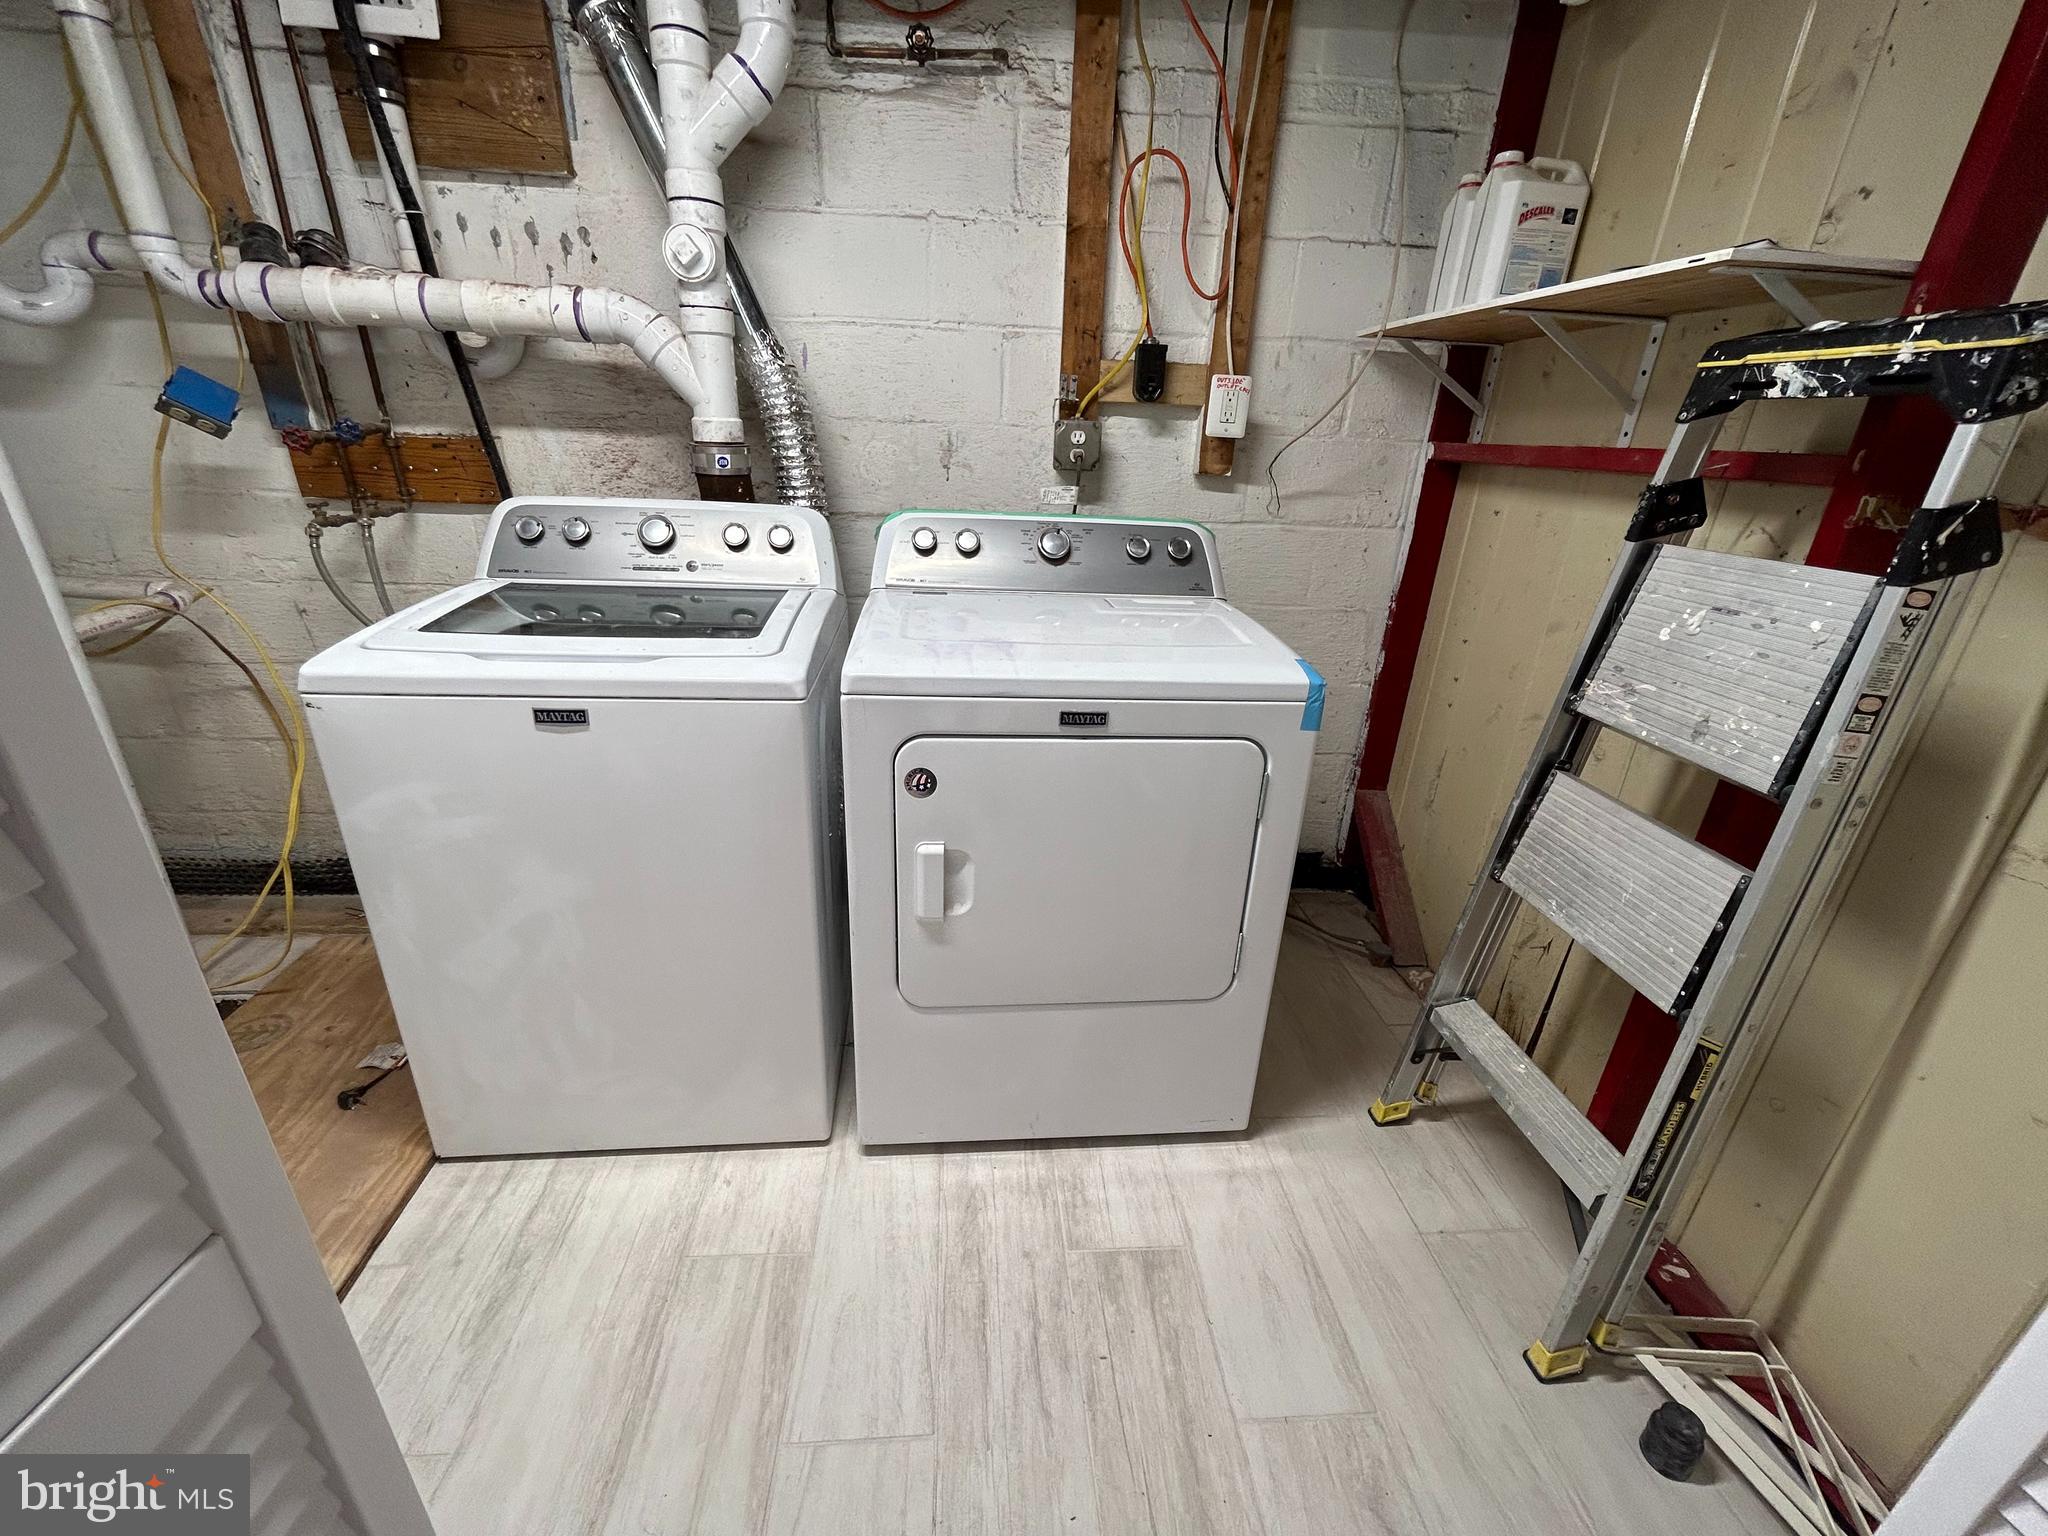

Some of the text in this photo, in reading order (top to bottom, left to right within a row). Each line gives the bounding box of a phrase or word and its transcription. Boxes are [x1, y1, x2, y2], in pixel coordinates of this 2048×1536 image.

[1518, 206, 1555, 226] DESCALER
[536, 711, 585, 721] MAYTAG
[1062, 714, 1105, 724] MAYTAG
[1694, 1061, 1713, 1091] HYBRID
[1656, 1101, 1687, 1149] LADDERS
